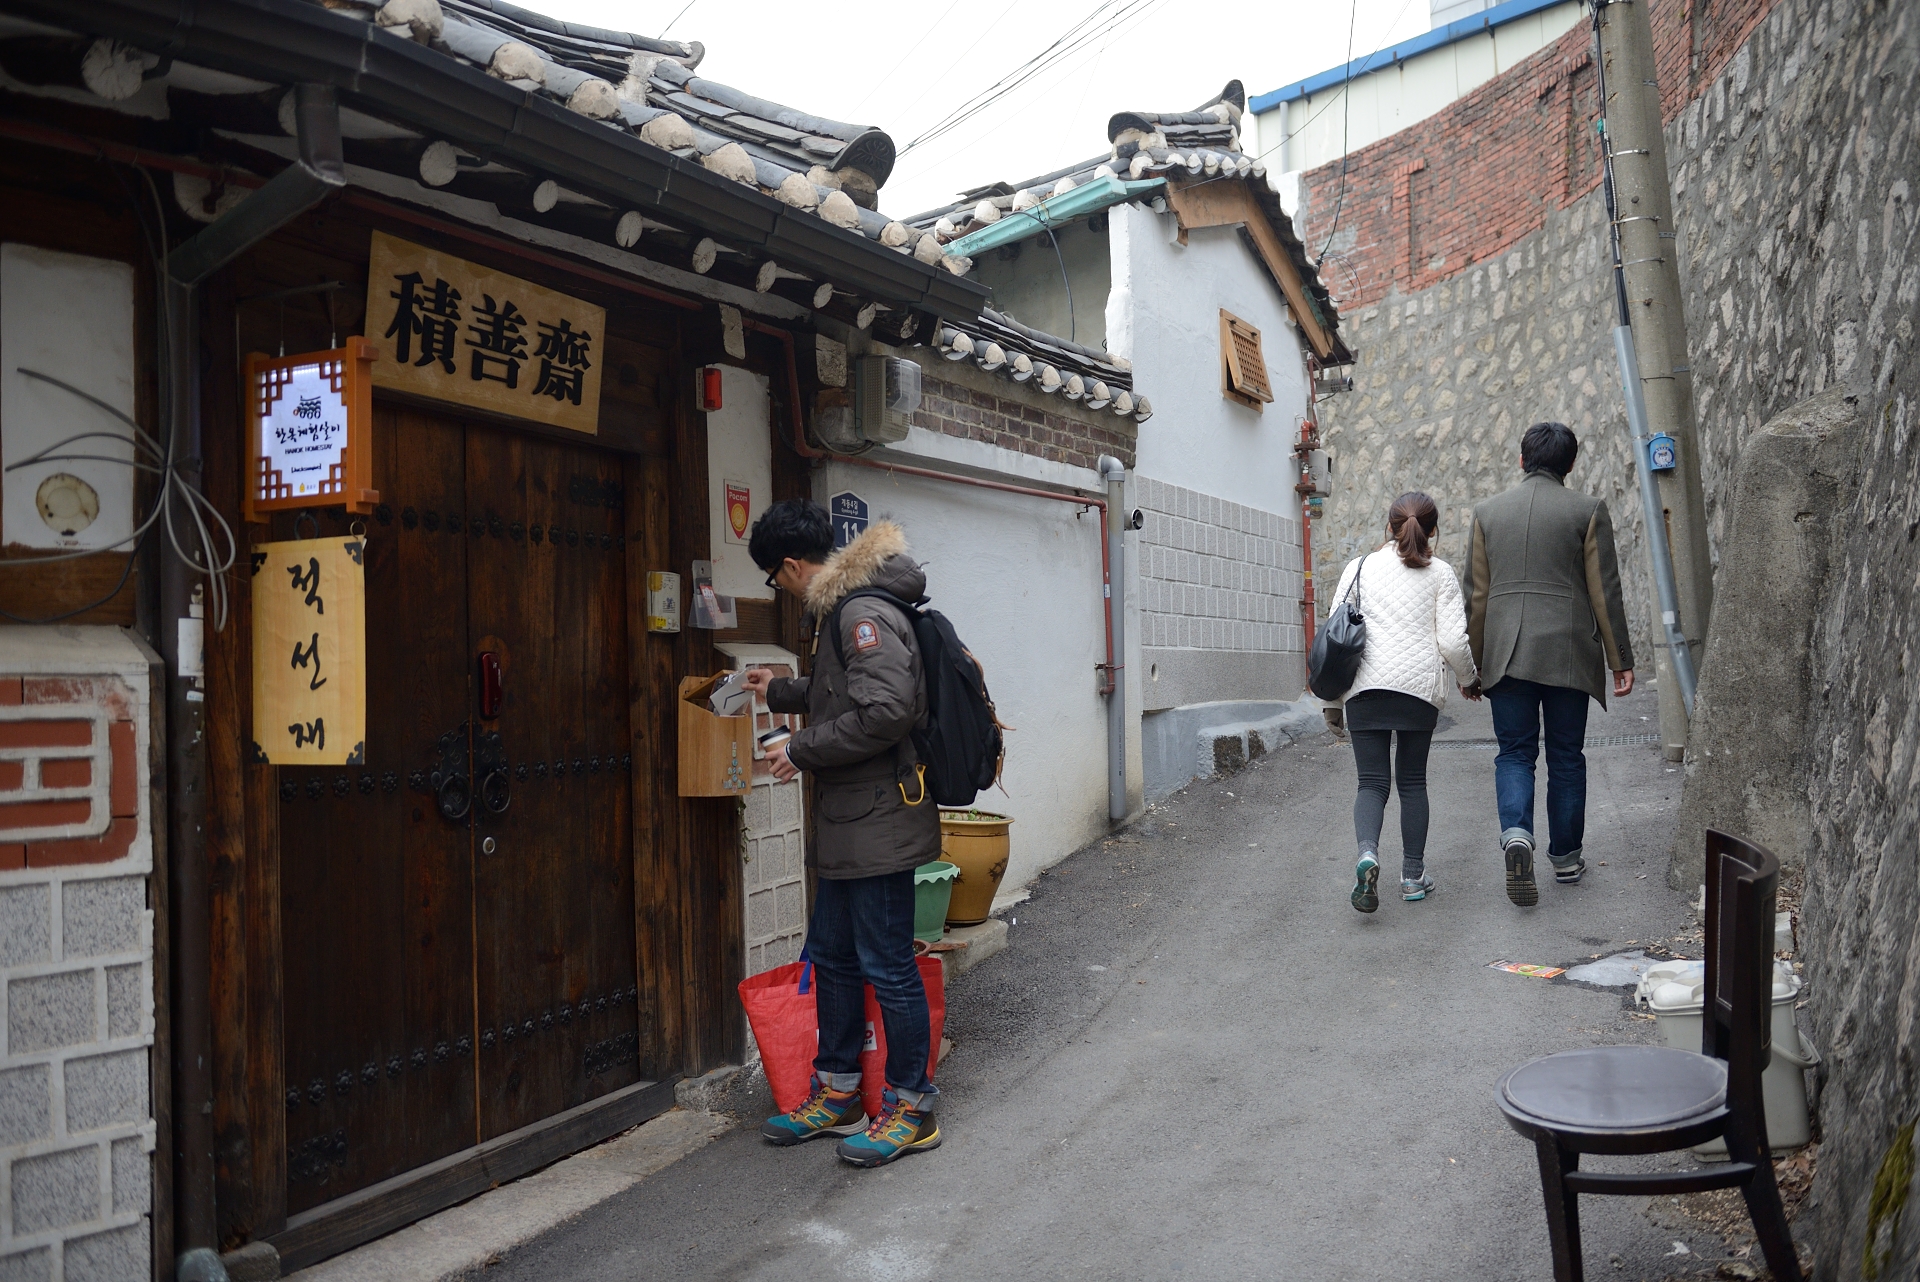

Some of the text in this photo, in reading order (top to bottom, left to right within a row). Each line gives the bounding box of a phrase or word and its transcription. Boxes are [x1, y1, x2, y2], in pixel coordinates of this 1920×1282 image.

[385, 271, 592, 406] 積善齋
[275, 421, 340, 444] 한옥체험살이
[285, 443, 333, 455] HANOK HOMESTAY
[842, 521, 858, 544] 11
[287, 557, 327, 750] 적선재
